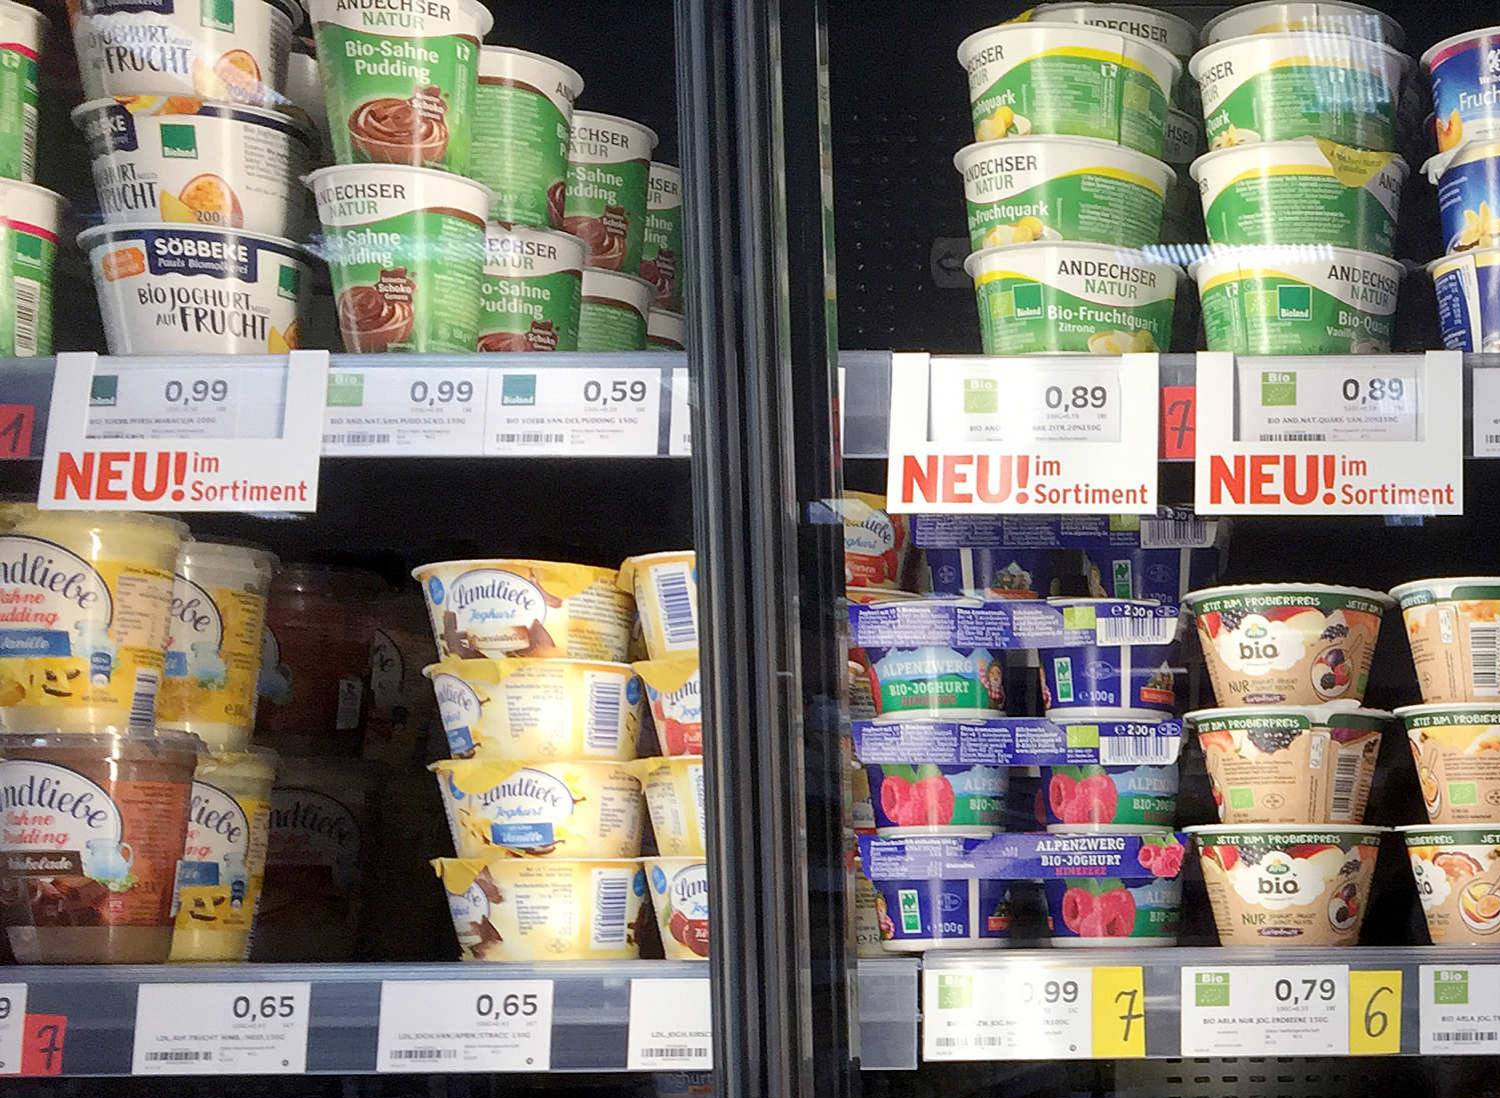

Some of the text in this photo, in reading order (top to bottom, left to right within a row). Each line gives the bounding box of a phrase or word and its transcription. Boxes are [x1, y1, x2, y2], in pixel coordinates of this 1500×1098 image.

[362, 12, 425, 31] NATUR
[106, 47, 190, 74] FRUCHT
[345, 41, 439, 64] Bio-Sahne
[355, 60, 430, 85] Pudding
[154, 237, 249, 263] SÖBBEKE
[1057, 259, 1157, 289] ANDECHSER
[168, 286, 251, 312] JOGHURT
[1084, 279, 1138, 300] NATUR
[180, 306, 270, 341] FRUCHT
[1047, 305, 1159, 334] Bio-Fruchtquark
[1280, 308, 1310, 319] Bioland
[1058, 322, 1096, 335] Zitrone
[1268, 373, 1291, 382] Bio
[165, 379, 228, 405] 0,99
[410, 380, 474, 407] 0,99
[583, 380, 648, 406] 0,59
[1044, 386, 1107, 412] 0,89
[1342, 377, 1404, 405] 0,89
[1168, 399, 1195, 449] 7
[193, 452, 219, 473] im
[1035, 455, 1061, 476] im
[1341, 455, 1367, 476] im
[54, 452, 188, 501] NEU!
[902, 455, 1030, 504] NEU!
[1210, 455, 1337, 505] NEU!
[191, 480, 307, 502] Sortiment
[1034, 483, 1148, 505] Sortiment
[1341, 483, 1454, 505] Sortiment
[454, 577, 537, 610] Landliebe
[1245, 594, 1321, 608] PROBIERPREIS
[1240, 639, 1279, 661] bio
[1233, 716, 1301, 729] PROBIERPREIS
[1035, 836, 1126, 853] ALPENZWERG
[1242, 834, 1265, 845] ZUM
[1268, 833, 1342, 846] PROBIERPREIS
[1040, 853, 1122, 868] BIO-JOGHURT
[1257, 873, 1301, 894] bio
[1241, 911, 1267, 926] NUR
[1201, 973, 1225, 984] Bio
[1440, 971, 1463, 981] Bio
[1274, 978, 1336, 1006] 0,79
[232, 994, 297, 1023] 0,65
[476, 993, 540, 1022] 0,65
[1114, 989, 1144, 1042] 7
[1364, 986, 1394, 1038] 6
